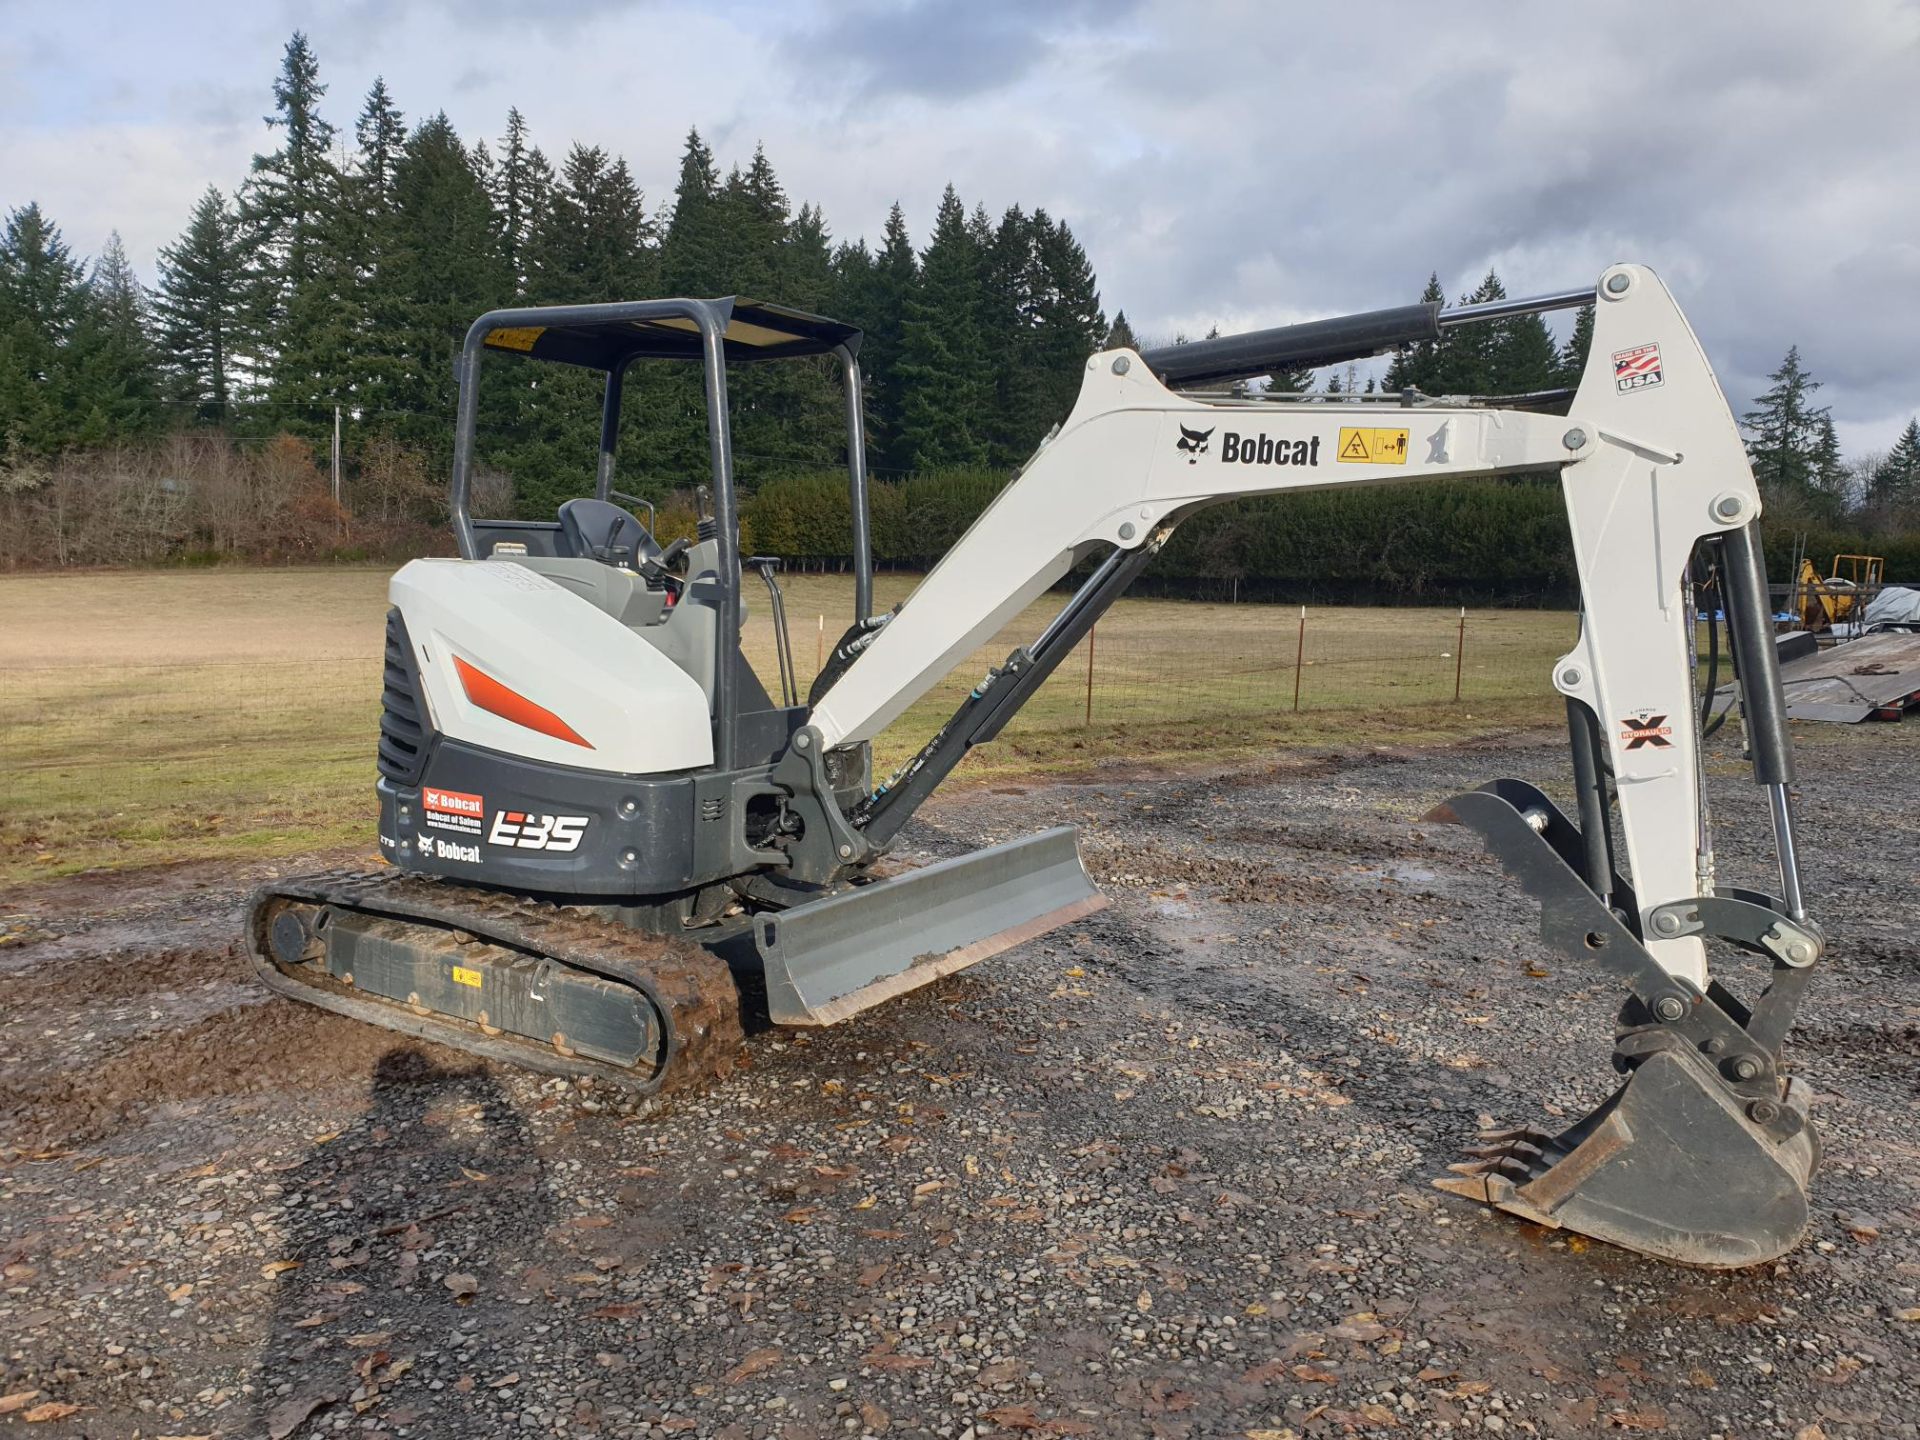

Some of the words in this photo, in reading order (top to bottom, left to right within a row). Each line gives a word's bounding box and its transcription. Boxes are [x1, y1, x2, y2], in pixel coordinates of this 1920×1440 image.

[1619, 373, 1660, 390] USA
[1221, 432, 1320, 467] Bobcat
[440, 794, 481, 813] Bobcat
[426, 810, 451, 823] Bobcat
[450, 815, 459, 824] of
[458, 816, 482, 829] Salem
[488, 811, 590, 852] E35
[436, 840, 481, 863] Bobcat
